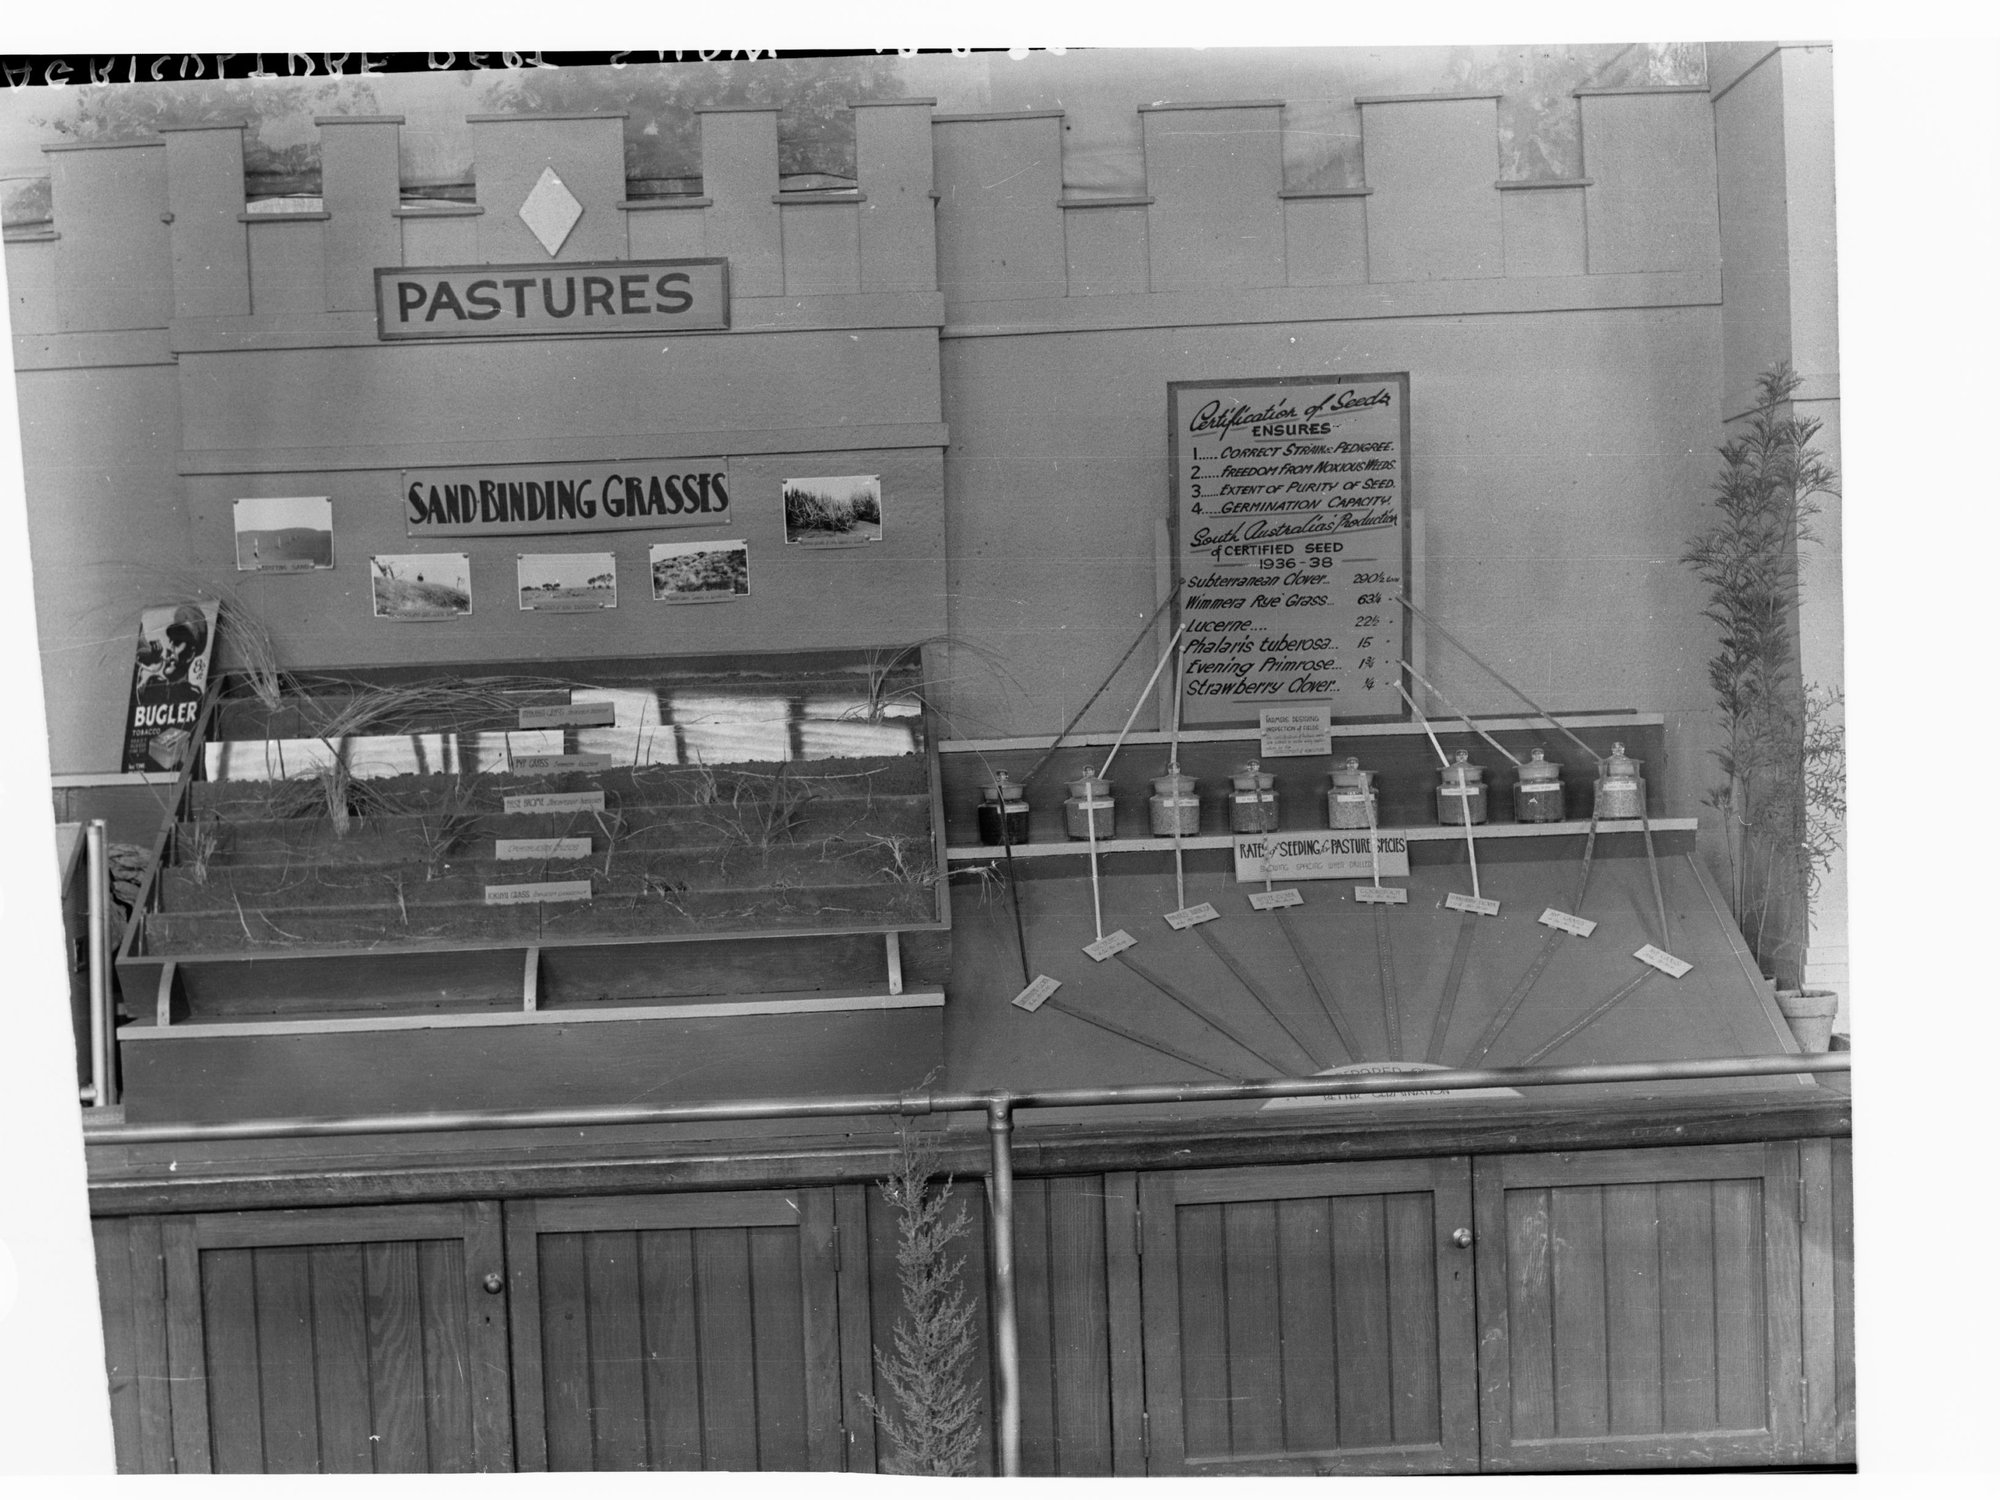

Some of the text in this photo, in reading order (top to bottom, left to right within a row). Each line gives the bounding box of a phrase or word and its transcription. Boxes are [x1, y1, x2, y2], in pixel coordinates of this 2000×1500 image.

[398, 272, 693, 322] PASTURES
[1190, 388, 1391, 440] Certification of Seeds
[1252, 423, 1331, 437] ENSURES
[1221, 447, 1282, 459] CORRECT
[1221, 464, 1279, 478] FREEDOM
[1278, 461, 1315, 475] FROM
[1313, 459, 1366, 473] NOXIOUS
[602, 473, 729, 517] GRASSES
[1219, 483, 1268, 496] EXTENT
[1266, 484, 1284, 494] OF
[1286, 480, 1339, 493] PURITY
[1343, 480, 1361, 490] OF
[1221, 499, 1322, 514] GERMINATION
[1190, 521, 1244, 548] South
[1333, 508, 1398, 534] Production
[1211, 542, 1344, 562] of CERTIFIED SEED
[1187, 572, 1280, 589] Subterranean
[1185, 594, 1246, 610] Wimmera
[1250, 594, 1279, 608] Rye
[1184, 635, 1254, 654] Phalaris
[1357, 636, 1374, 649] 15
[1186, 656, 1254, 677] Evening
[1186, 677, 1284, 697] Strawberry
[134, 701, 197, 727] BUGLER
[132, 728, 161, 737] TOBACCO
[1280, 840, 1320, 858] SEEDING
[1331, 838, 1371, 855] PASTURE
